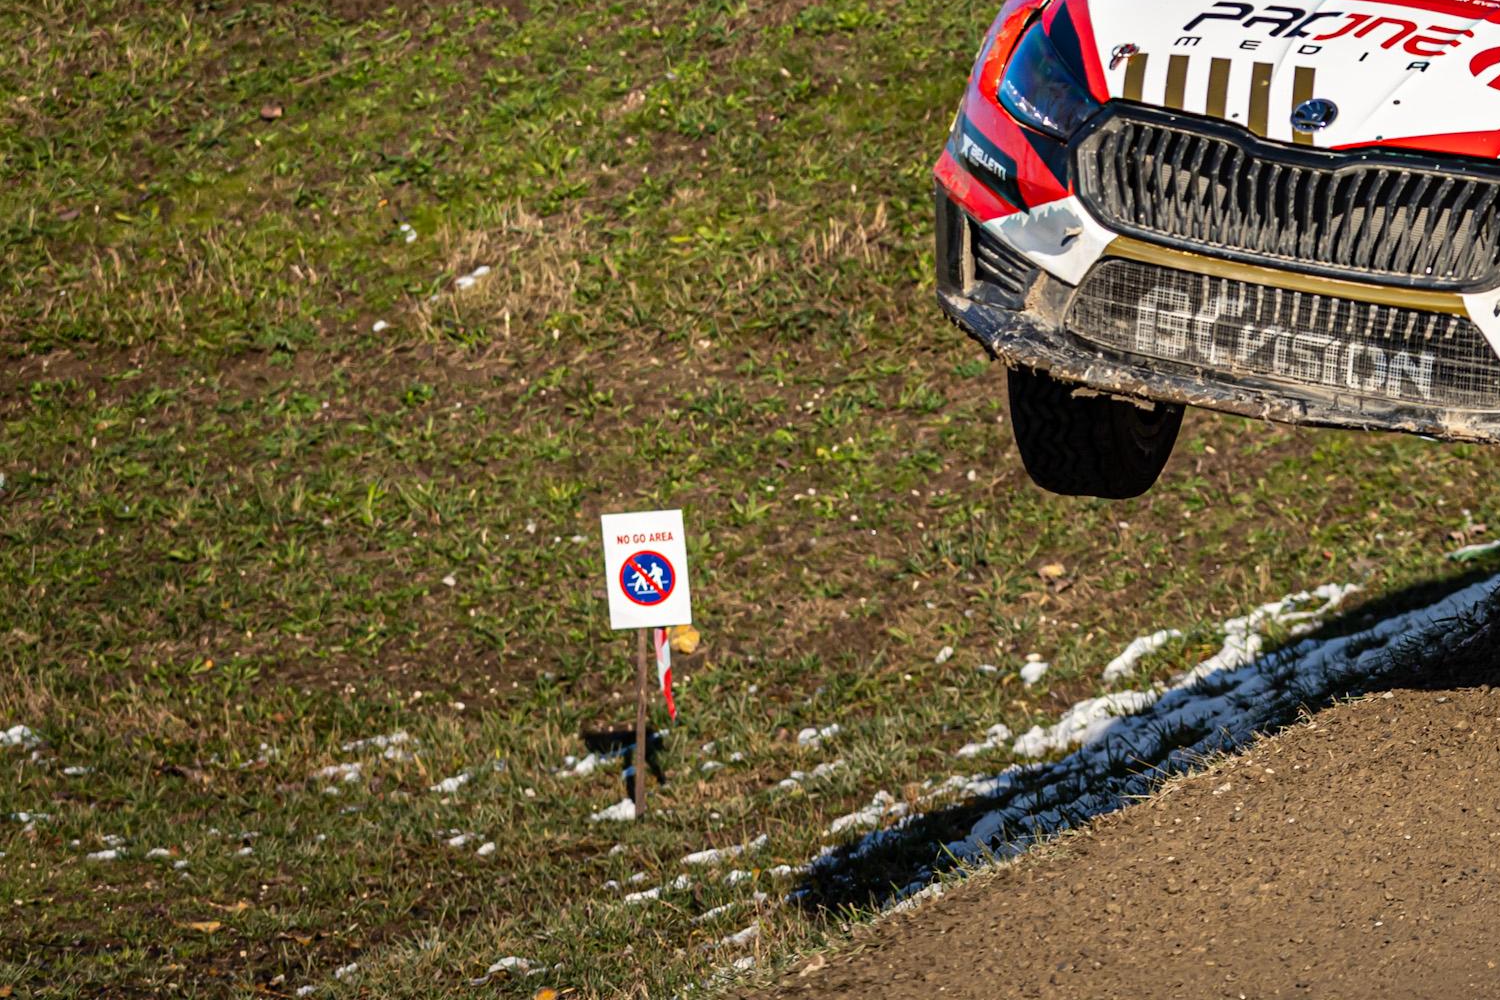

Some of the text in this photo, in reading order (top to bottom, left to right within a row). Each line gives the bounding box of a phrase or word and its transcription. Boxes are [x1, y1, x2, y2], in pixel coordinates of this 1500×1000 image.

[1174, 36, 1431, 72] MEDIA
[616, 531, 674, 545] NO GO AREA
